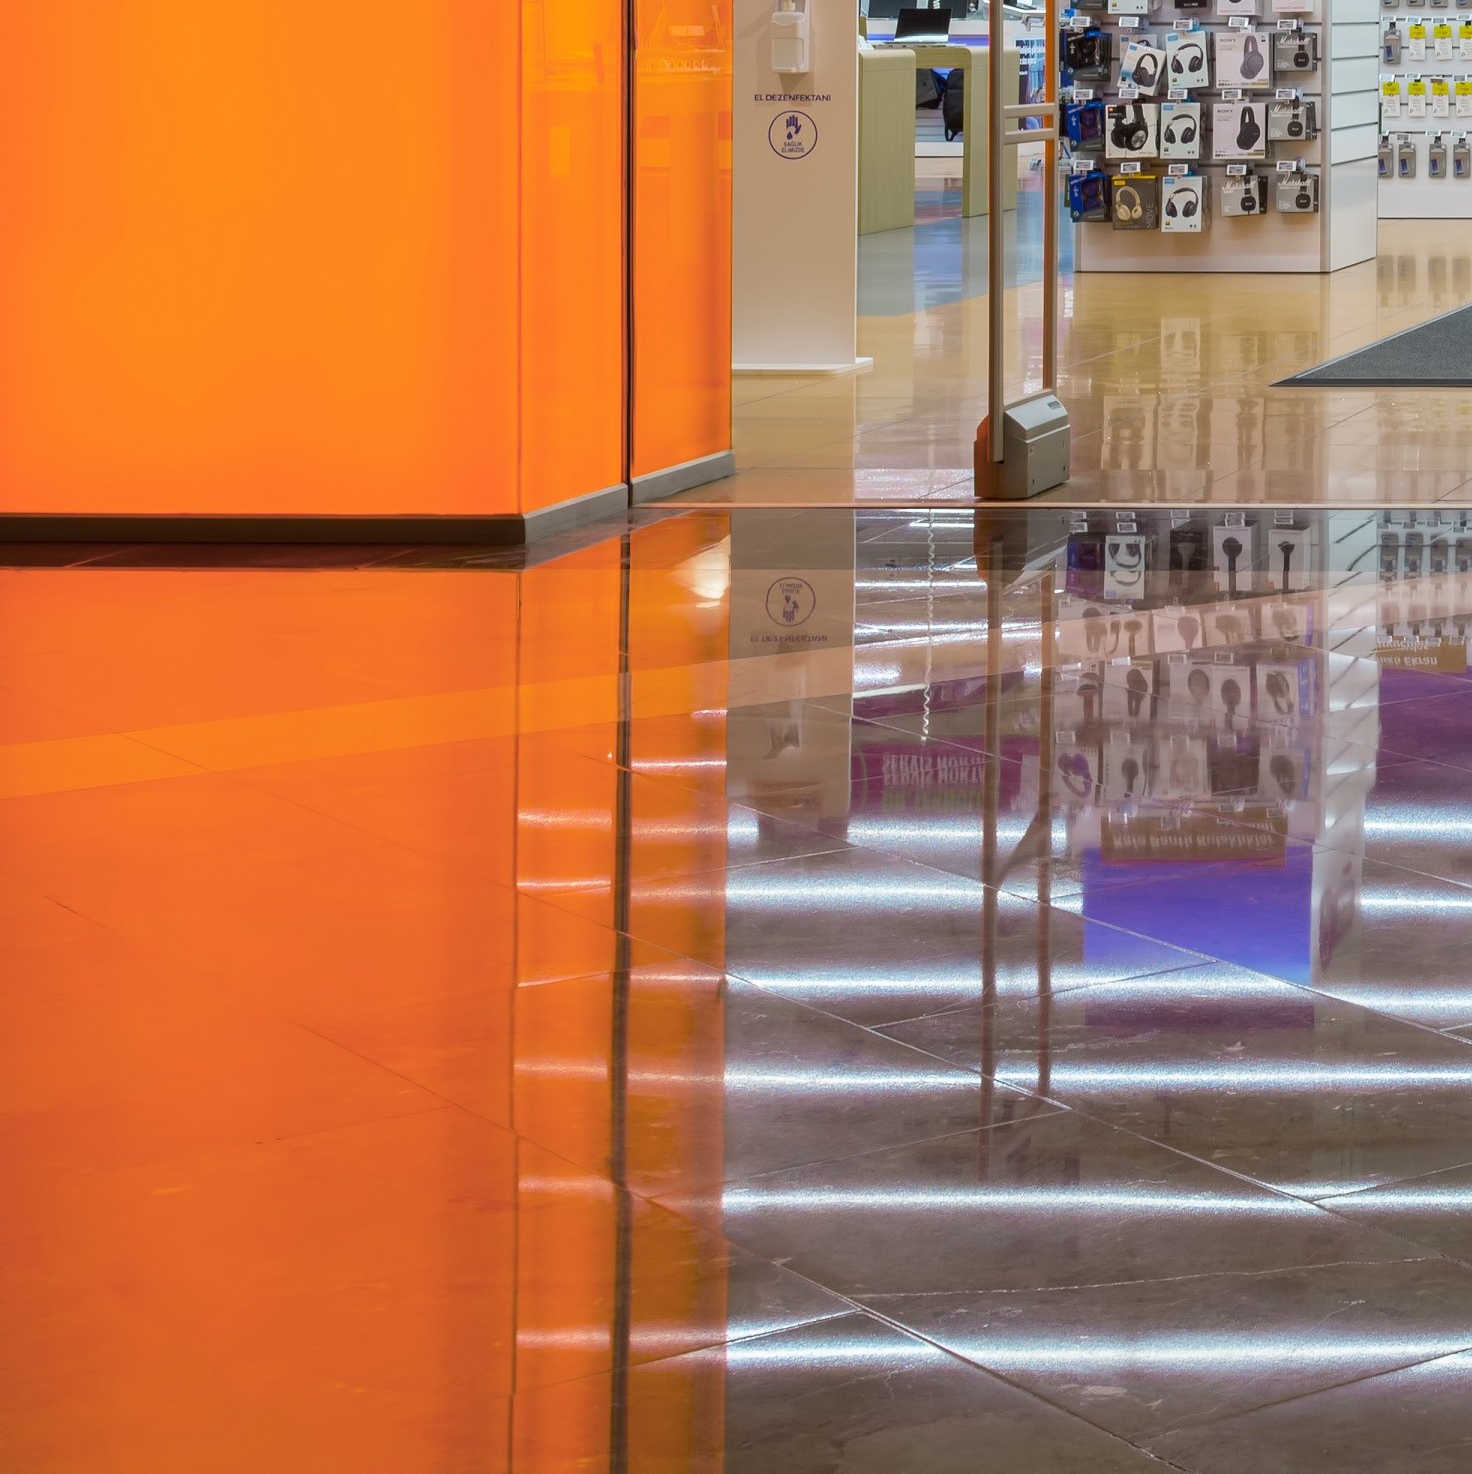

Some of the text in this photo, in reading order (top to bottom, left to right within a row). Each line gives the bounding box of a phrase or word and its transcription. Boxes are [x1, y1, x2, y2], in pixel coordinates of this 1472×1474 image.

[1277, 35, 1311, 45] Marshall
[754, 94, 832, 102] EL DEZENFEKTANI
[1222, 180, 1257, 190] Marshall
[1278, 177, 1312, 187] Marshall
